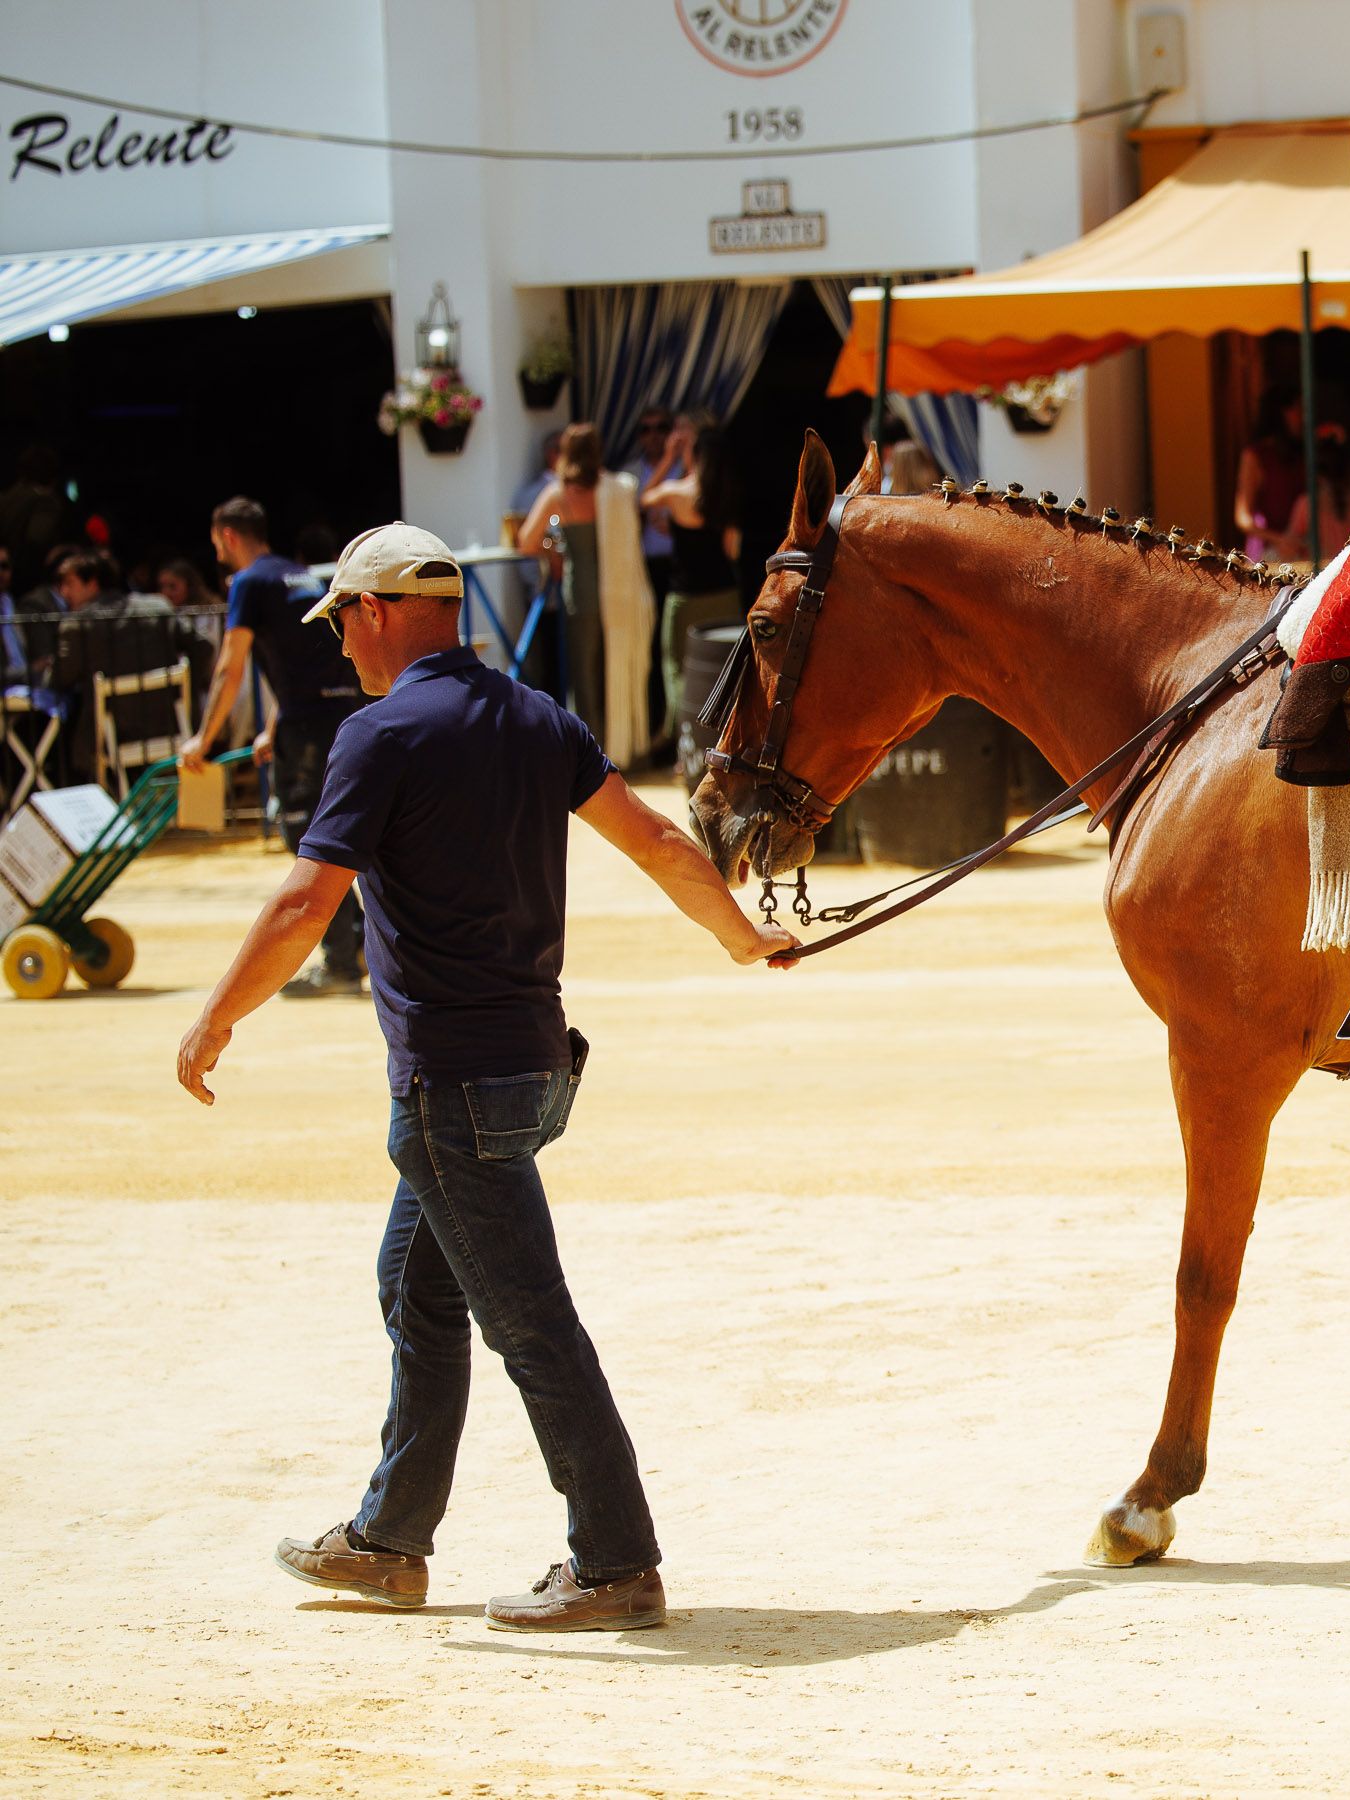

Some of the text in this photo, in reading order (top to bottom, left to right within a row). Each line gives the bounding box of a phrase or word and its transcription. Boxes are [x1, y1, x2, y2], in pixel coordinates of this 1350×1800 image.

[691, 0, 835, 61] AL RELENTE
[10, 112, 234, 182] Relente
[725, 106, 804, 143] 1958
